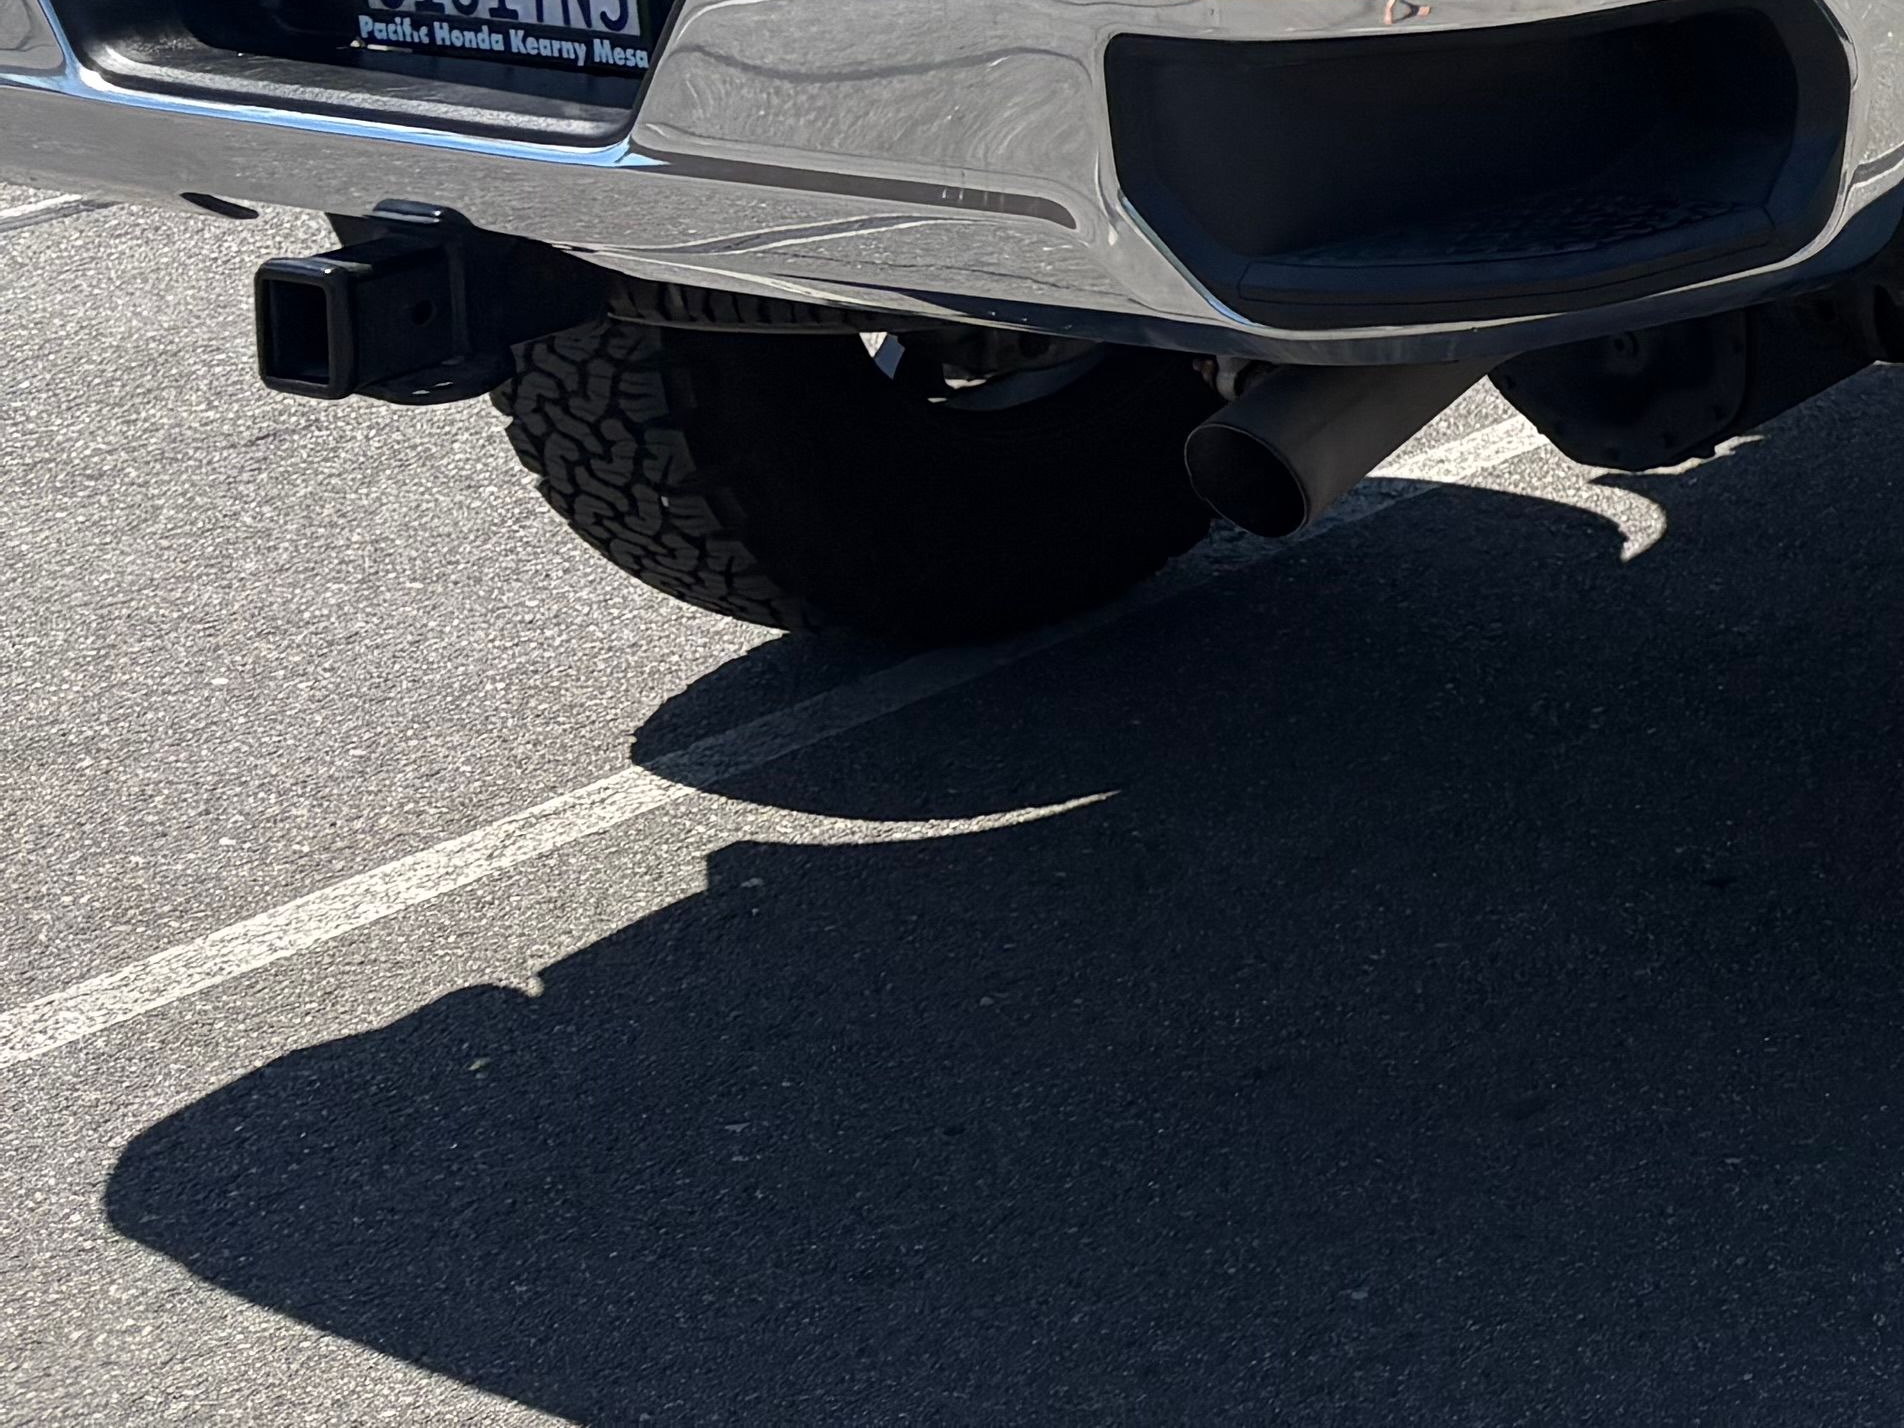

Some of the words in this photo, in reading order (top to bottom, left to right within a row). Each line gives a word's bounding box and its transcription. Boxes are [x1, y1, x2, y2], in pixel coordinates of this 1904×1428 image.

[358, 15, 430, 44] Pacific
[433, 21, 505, 52] Honda
[508, 29, 588, 66] Kearny
[593, 38, 650, 70] Mesa
